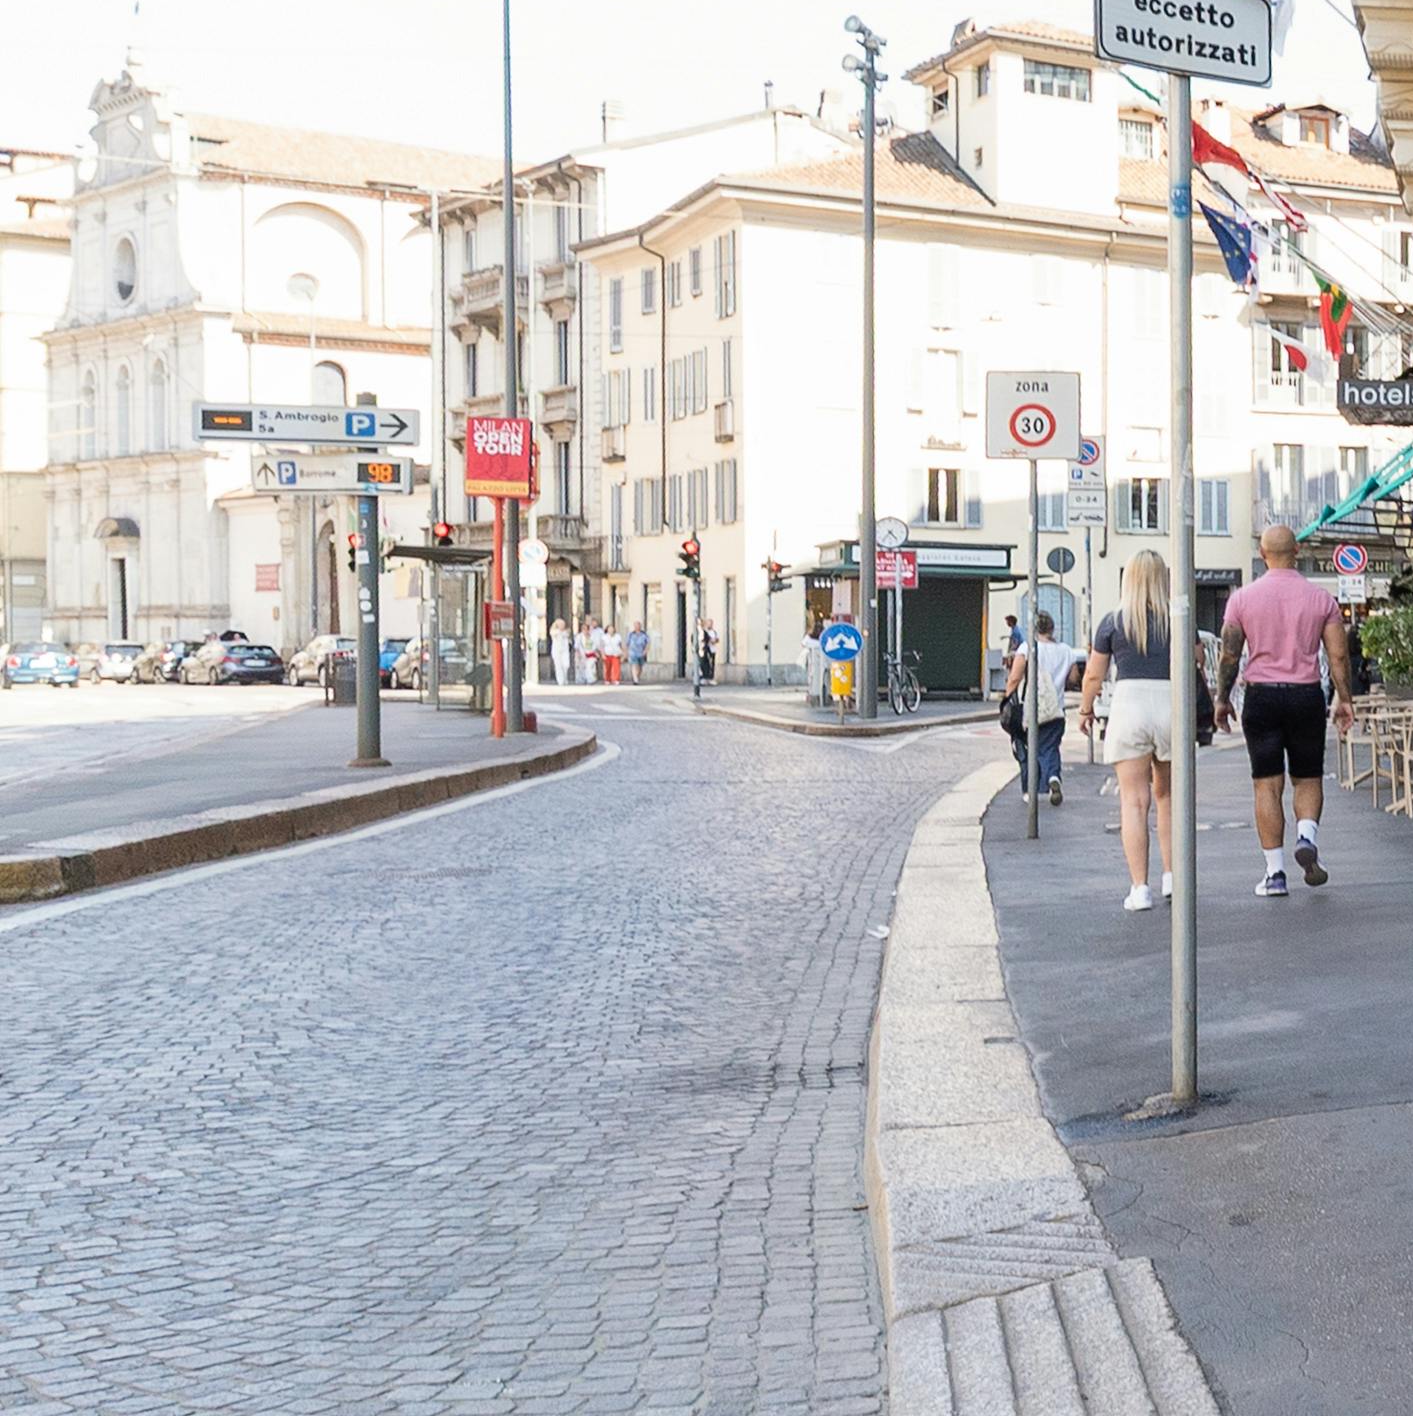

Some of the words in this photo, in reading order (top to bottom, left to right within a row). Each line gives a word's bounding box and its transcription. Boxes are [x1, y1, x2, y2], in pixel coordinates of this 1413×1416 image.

[1116, 22, 1256, 67] autorizzati
[1015, 381, 1049, 393] zona
[275, 411, 339, 423] Ambrogio
[473, 419, 524, 433] MILAN
[1021, 417, 1044, 434] 30
[473, 432, 523, 445] OPEN
[474, 441, 522, 456] TOUR
[366, 463, 393, 482] 98
[1318, 561, 1389, 572] TACHI
